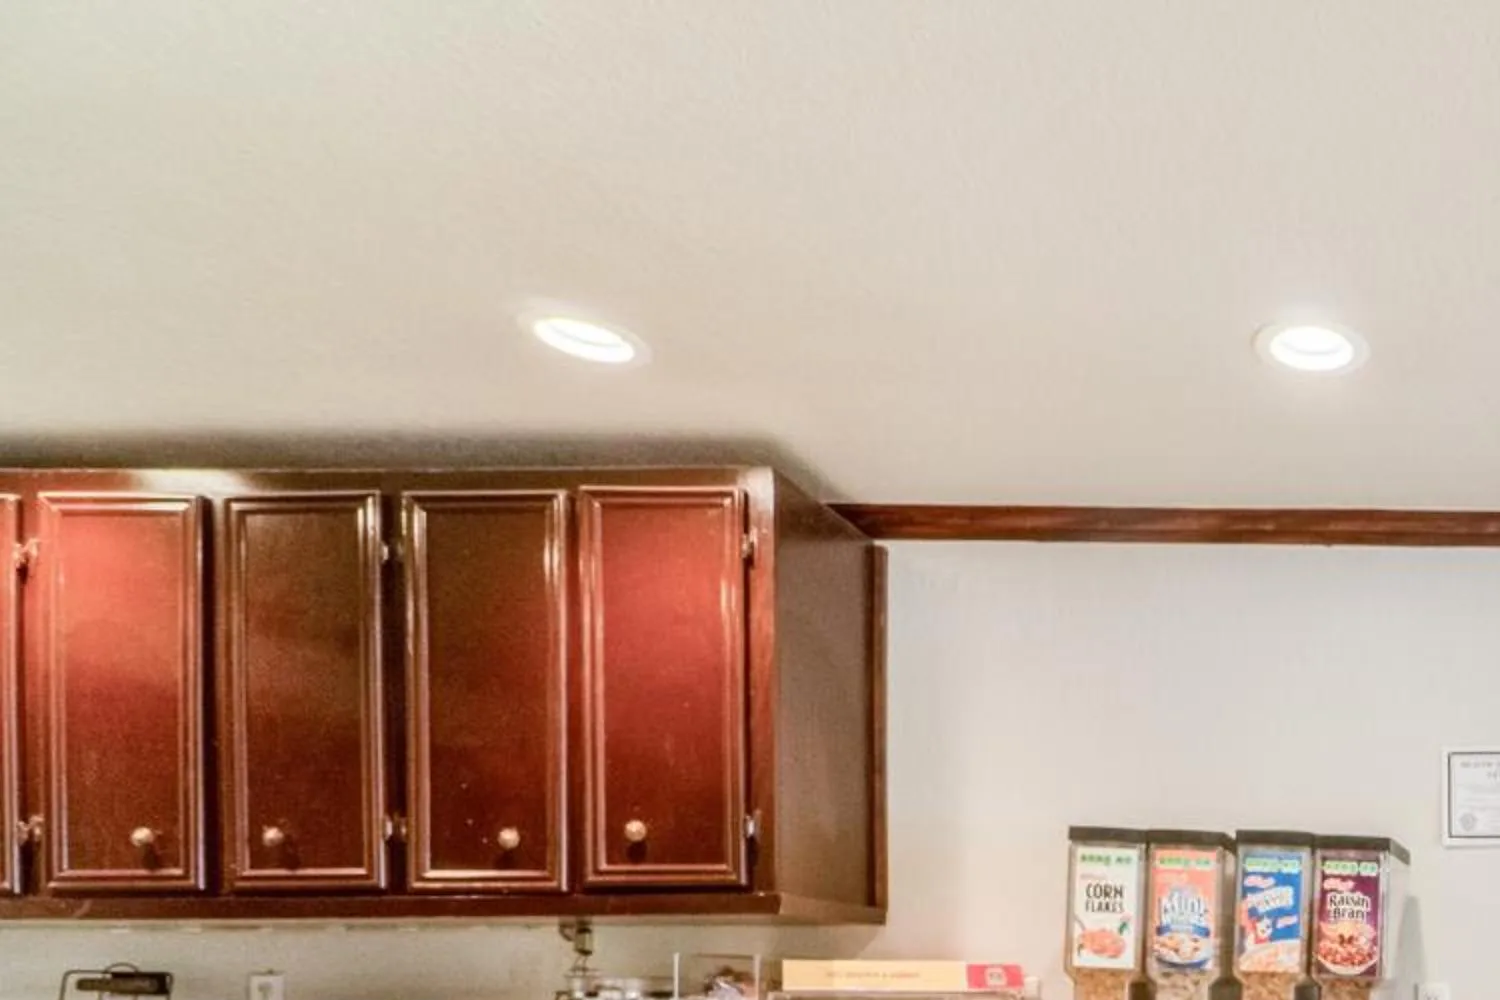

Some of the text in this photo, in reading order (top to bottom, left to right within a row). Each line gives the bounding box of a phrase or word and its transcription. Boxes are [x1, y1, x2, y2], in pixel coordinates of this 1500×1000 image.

[1085, 883, 1124, 898] CORN
[1085, 900, 1125, 913] FLAKES
[1329, 894, 1369, 908] Raisin
[1333, 907, 1365, 920] Bran
